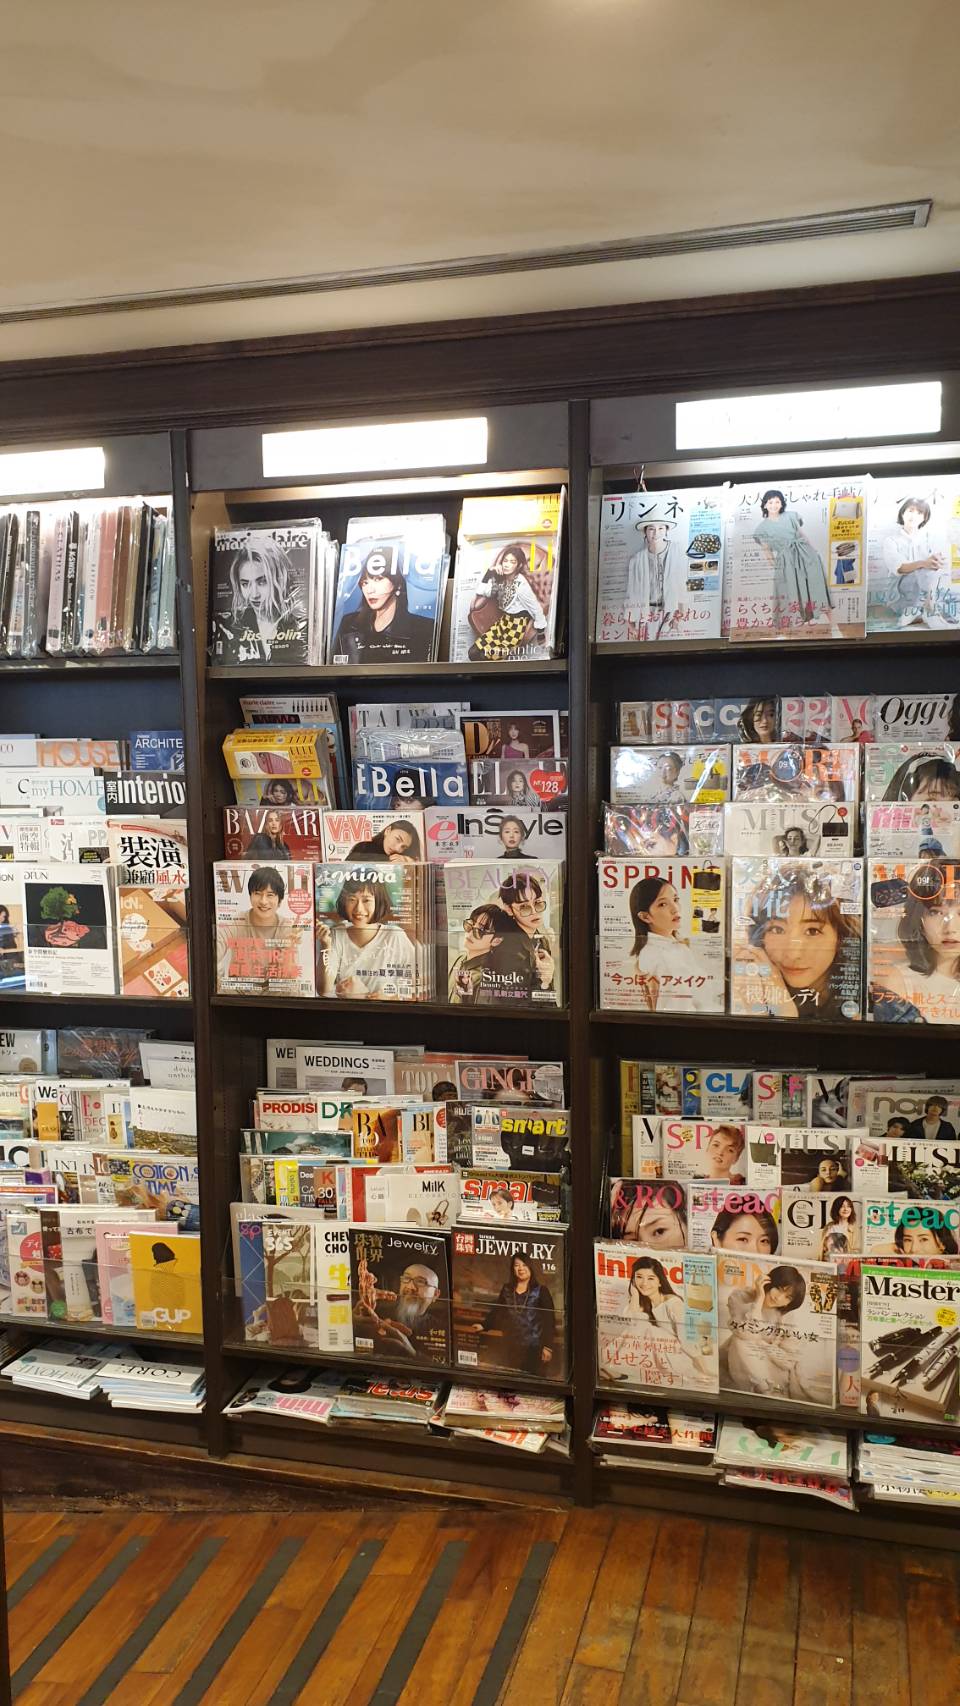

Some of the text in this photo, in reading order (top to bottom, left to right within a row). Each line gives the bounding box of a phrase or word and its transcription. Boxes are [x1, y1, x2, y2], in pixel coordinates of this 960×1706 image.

[880, 695, 950, 727] Oggi
[39, 742, 121, 768] HOUSE
[117, 772, 186, 806] interio
[371, 767, 464, 799] Bella
[120, 836, 183, 869] 裝潢
[331, 867, 397, 884] mina
[482, 970, 524, 986] Single
[305, 1055, 370, 1069] WEDDINGS
[501, 1117, 567, 1136] smart
[132, 1163, 189, 1182] COTTON
[144, 1180, 177, 1197] TIME
[317, 1187, 334, 1199] 30
[422, 1180, 446, 1193] MilK
[387, 1237, 438, 1256] Jewelry
[541, 1262, 557, 1271] 116
[866, 1276, 960, 1303] Master
